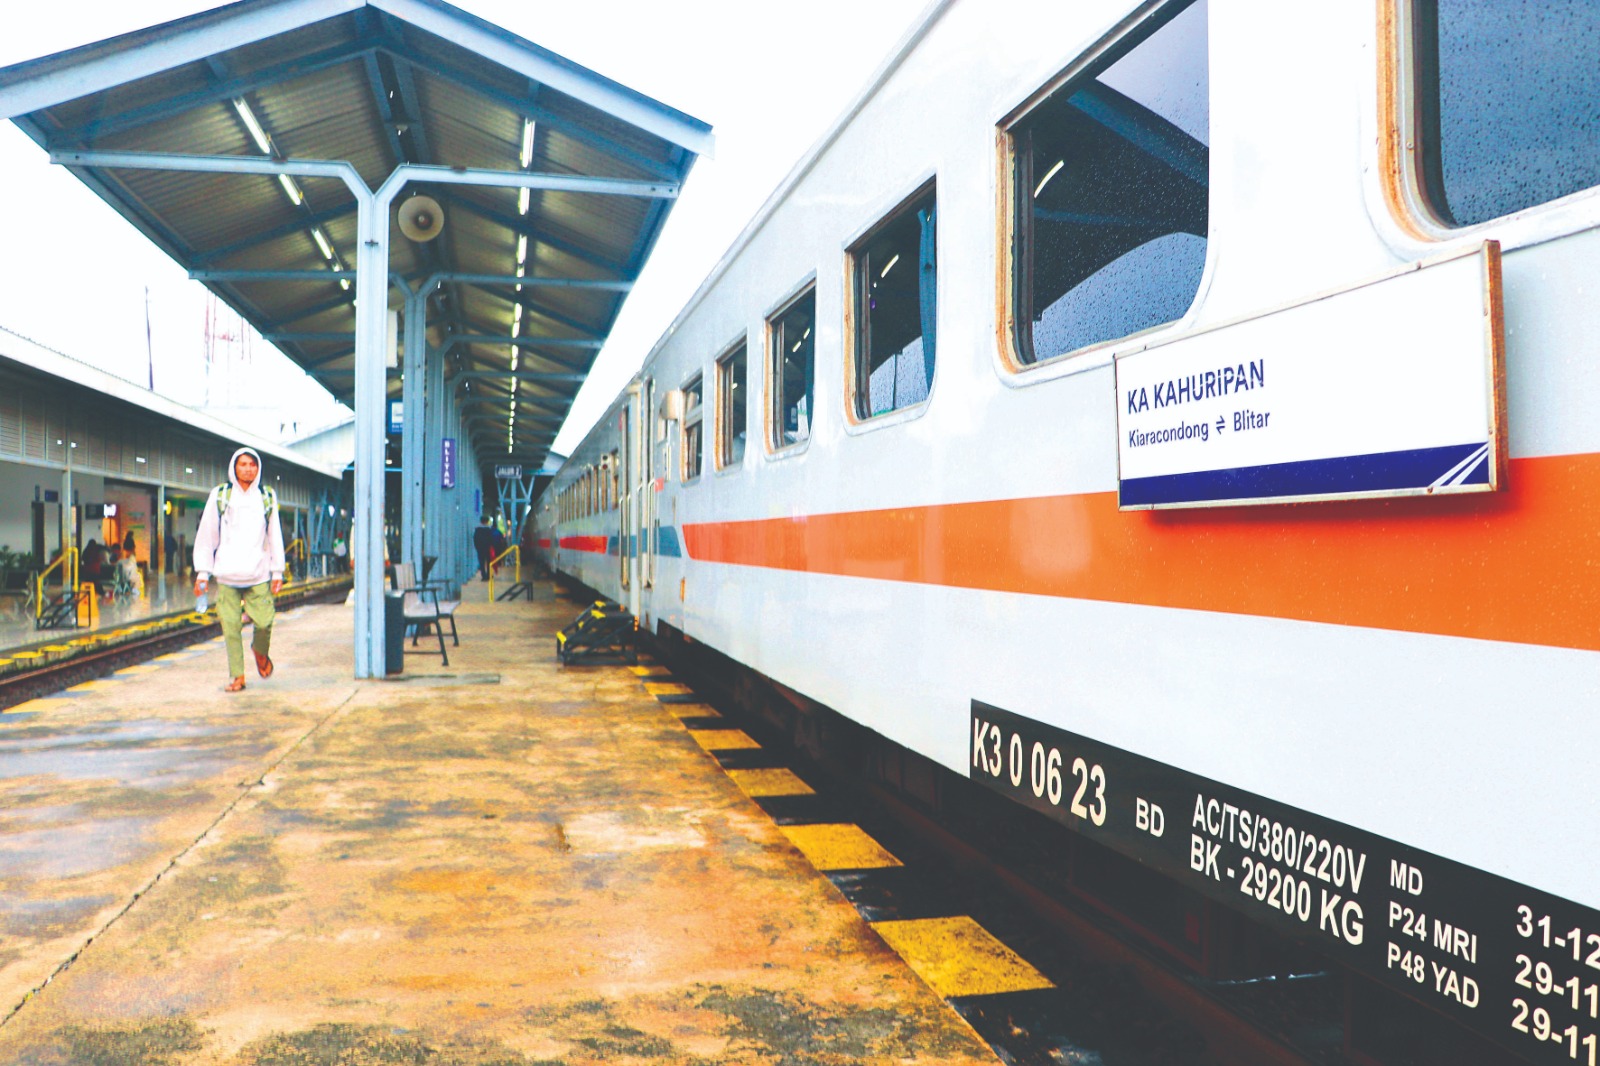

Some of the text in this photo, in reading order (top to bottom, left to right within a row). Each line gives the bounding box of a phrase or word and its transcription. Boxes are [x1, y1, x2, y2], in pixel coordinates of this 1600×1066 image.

[1127, 358, 1264, 415] KA KAHURIPAN
[1129, 409, 1270, 448] Kiaracondong Blitar
[973, 717, 1107, 827] K3 0 06 23
[1135, 797, 1165, 838] BD
[1192, 793, 1367, 895] AC/TS/380/220V
[1190, 833, 1222, 882] BK
[1240, 856, 1311, 922] 29200
[1319, 888, 1364, 946] KG
[1390, 859, 1423, 896] MD
[1389, 900, 1477, 964] P24 MRI
[1516, 904, 1600, 970] 31-12
[1387, 941, 1480, 1008] P48 YAD
[1514, 954, 1598, 1019] 29-11
[1511, 998, 1597, 1066] 29-11
